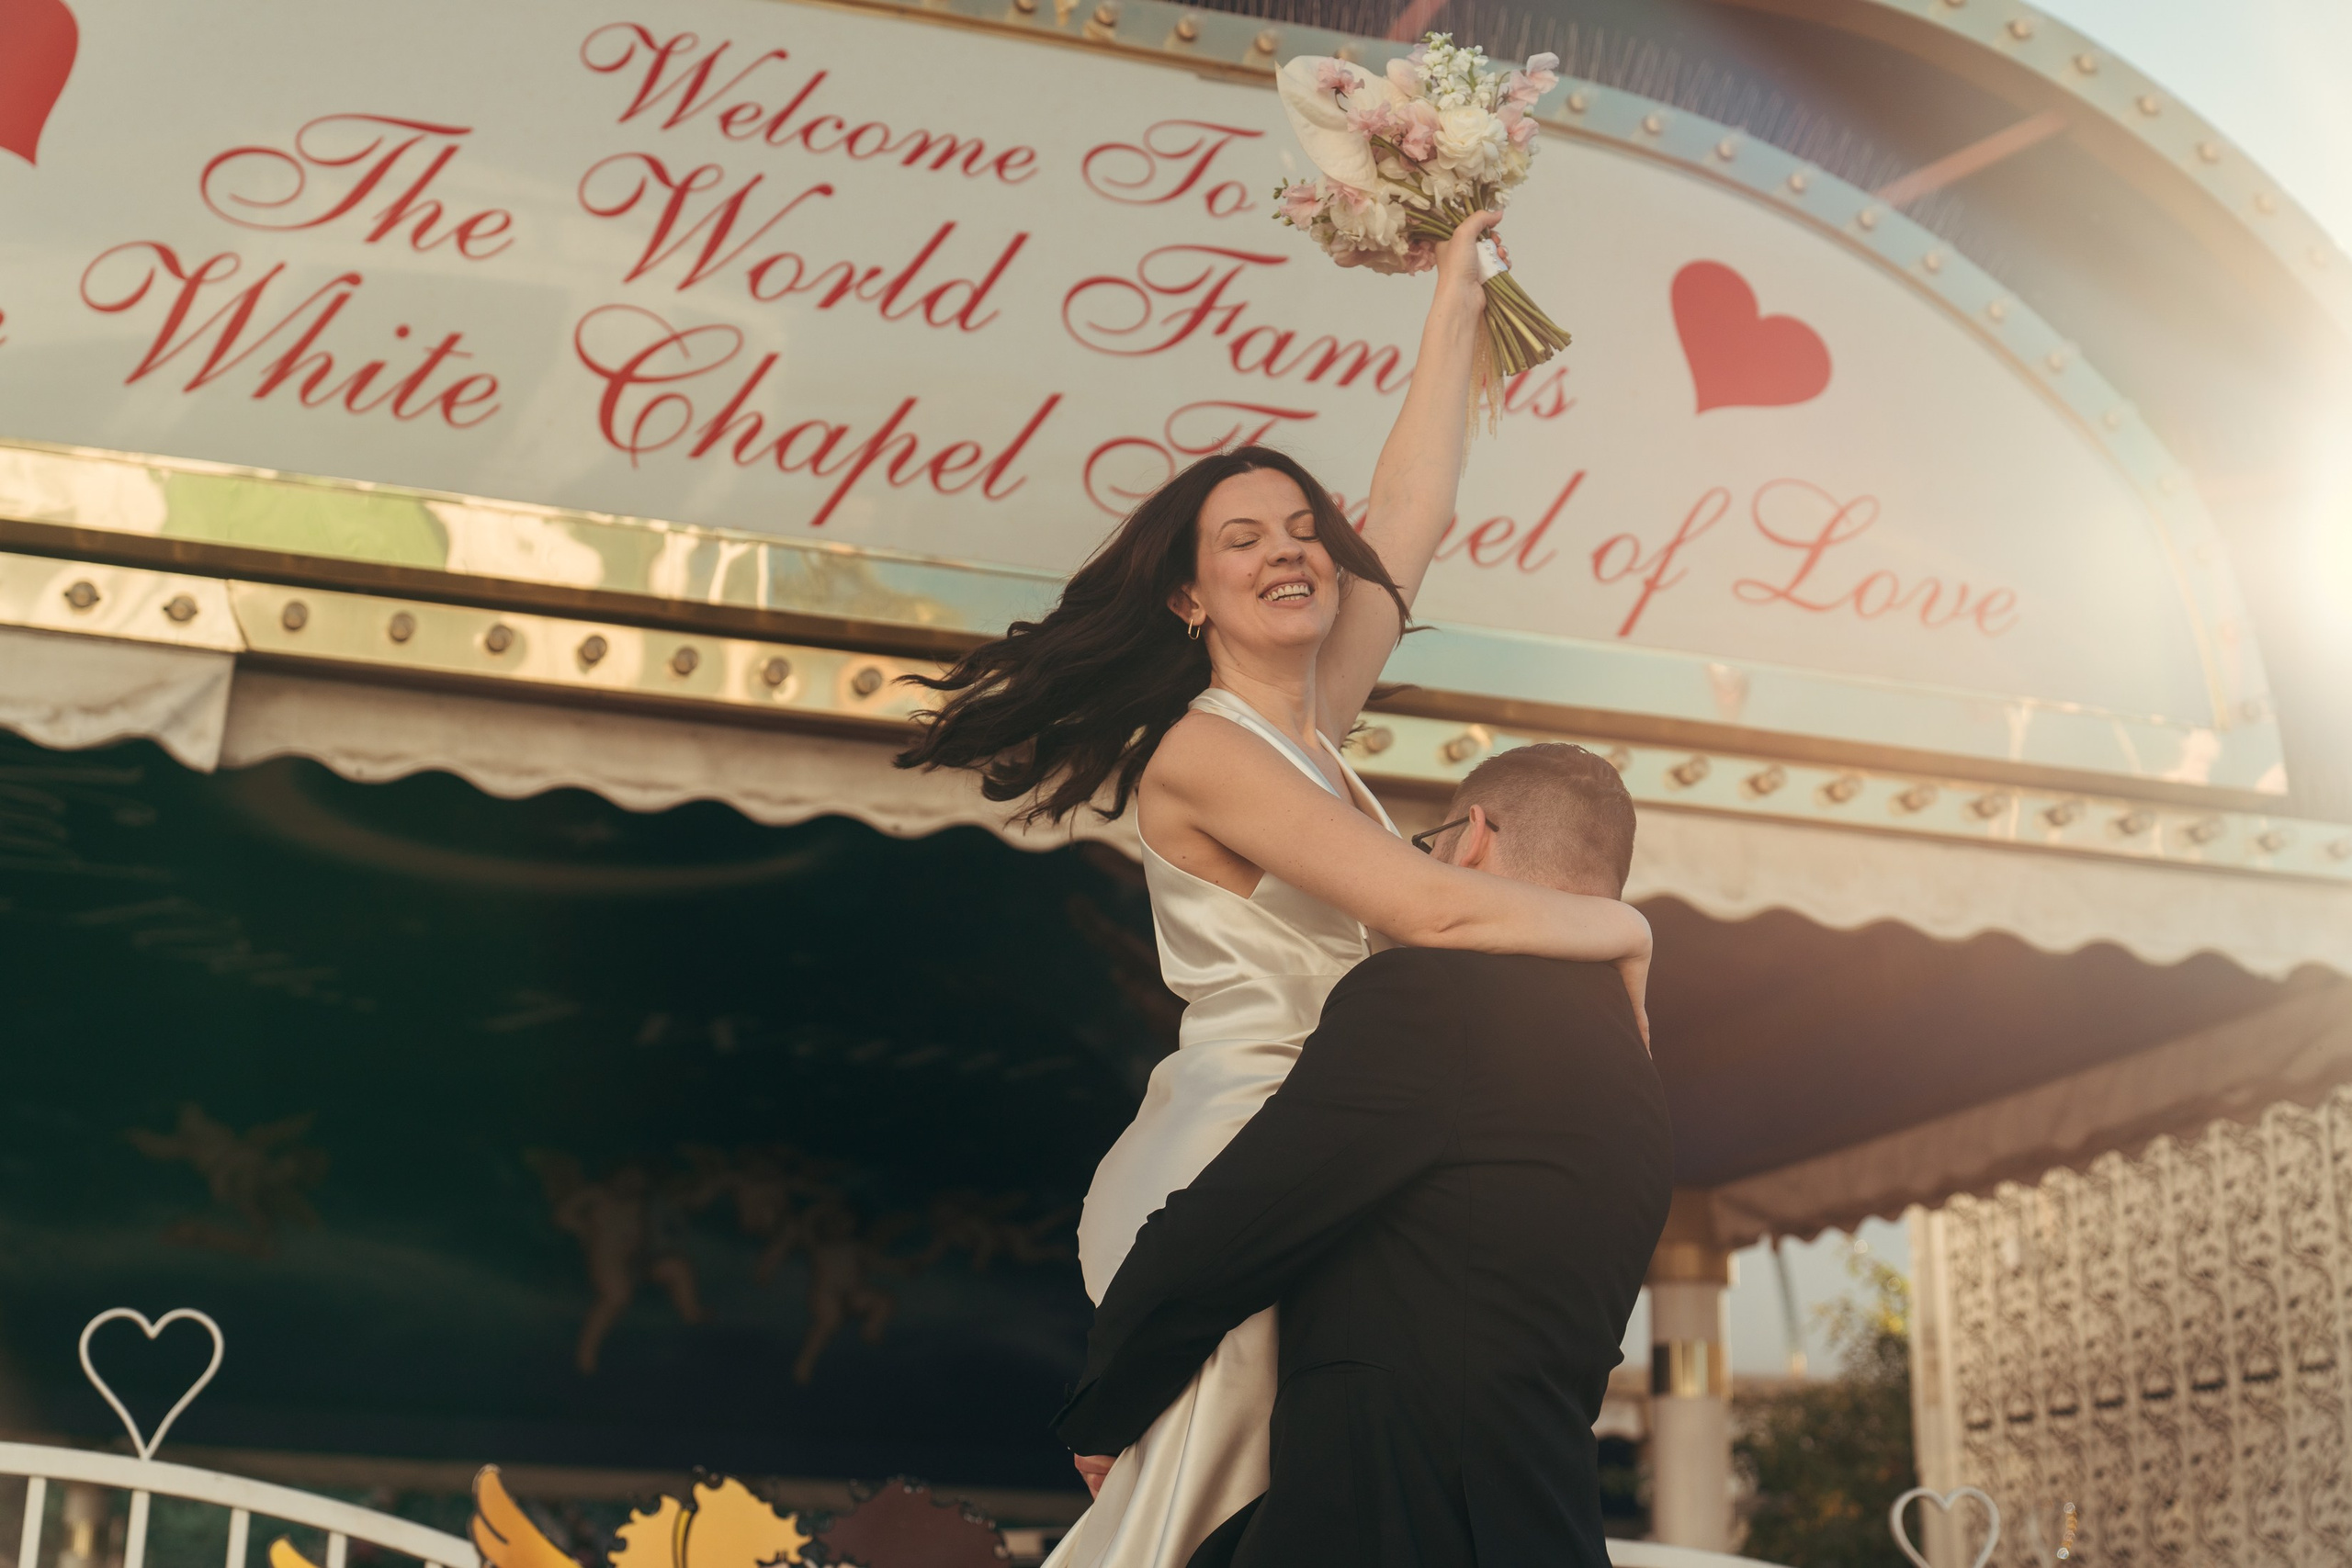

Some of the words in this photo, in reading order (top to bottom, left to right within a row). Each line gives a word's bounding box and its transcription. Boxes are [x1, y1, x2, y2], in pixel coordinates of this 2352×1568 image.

[198, 112, 516, 263] The
[576, 150, 1033, 334] World
[1060, 243, 1578, 423] Fams
[579, 21, 1040, 186] Welcome
[1080, 118, 1266, 220] To
[78, 240, 503, 430] White
[572, 302, 1066, 528] Chapel
[1589, 486, 1732, 639] of
[1730, 478, 2020, 637] Love
